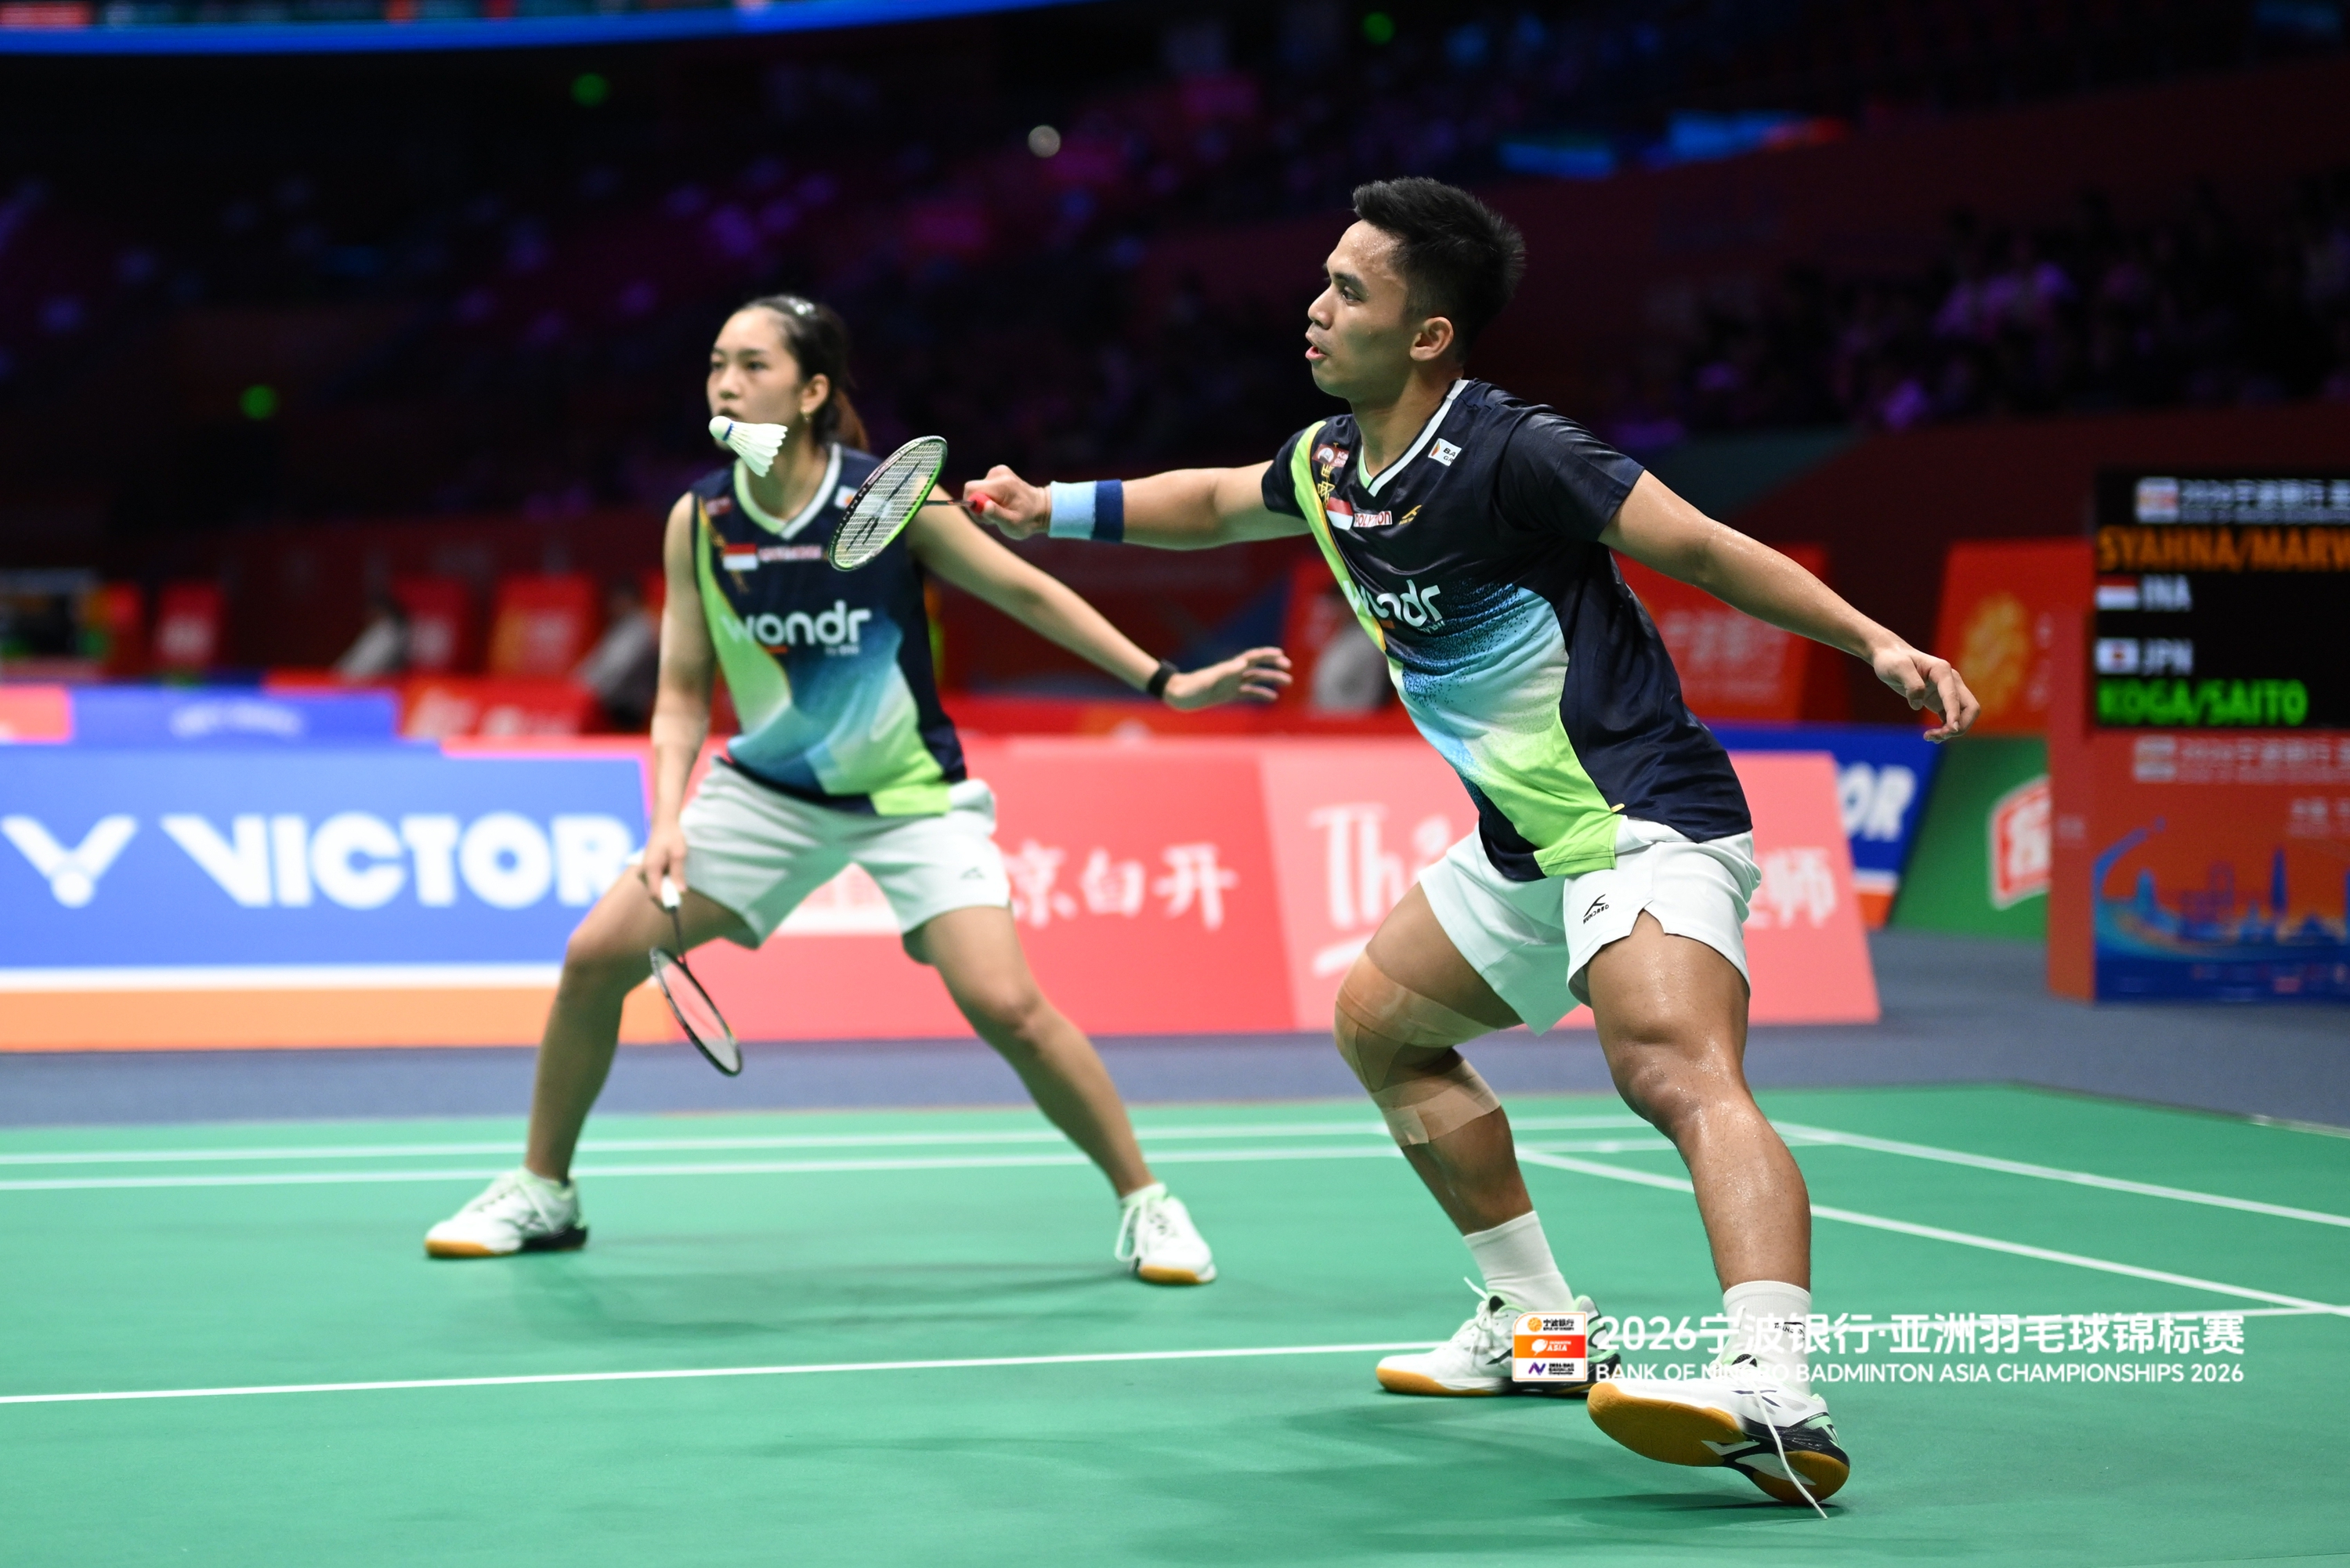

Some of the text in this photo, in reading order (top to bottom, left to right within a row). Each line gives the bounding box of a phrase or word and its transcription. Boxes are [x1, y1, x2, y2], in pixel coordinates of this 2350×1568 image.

[2141, 574, 2191, 612] INA
[718, 599, 872, 646] wondr
[2142, 638, 2193, 676] JPN
[2099, 677, 2308, 726] KOGA/SAITO
[161, 811, 636, 909] VICTOR
[1582, 904, 1609, 924] HUNDRED
